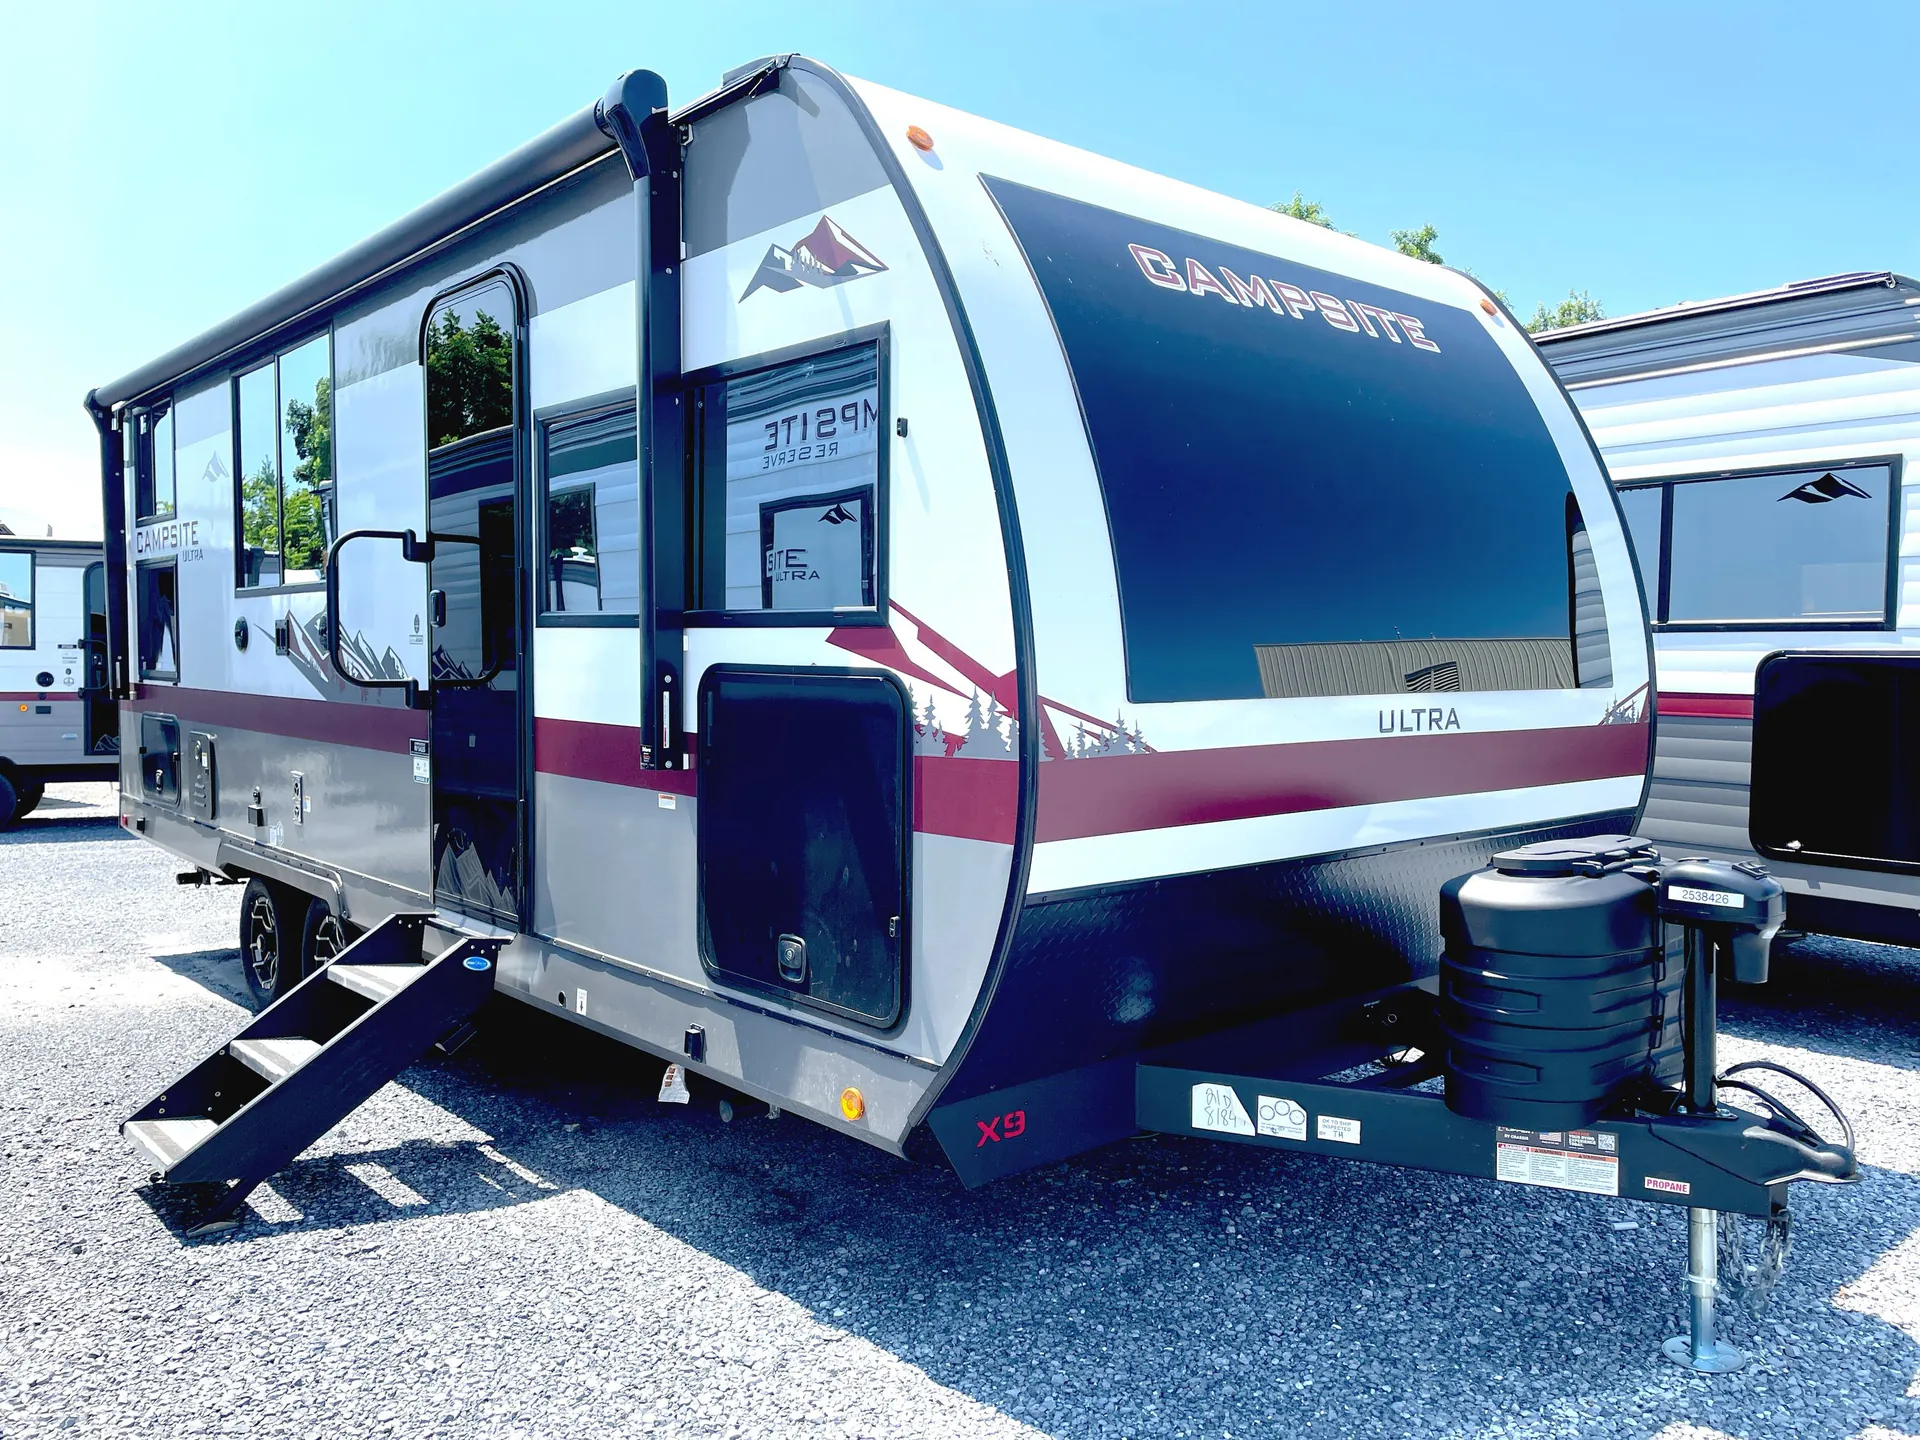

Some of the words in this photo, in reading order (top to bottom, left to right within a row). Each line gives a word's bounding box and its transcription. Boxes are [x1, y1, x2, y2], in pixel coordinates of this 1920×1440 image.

[1128, 243, 1441, 353] CAMPSITE
[136, 520, 199, 554] CAMPSITE
[182, 548, 204, 562] ULTRA
[775, 570, 820, 582] ULTRA
[1379, 707, 1461, 734] ULTRA
[1681, 889, 1729, 905] 2538426
[976, 1109, 1026, 1149] X9
[1322, 1124, 1352, 1132] INSPECTED
[1646, 1178, 1688, 1193] PROPANE
